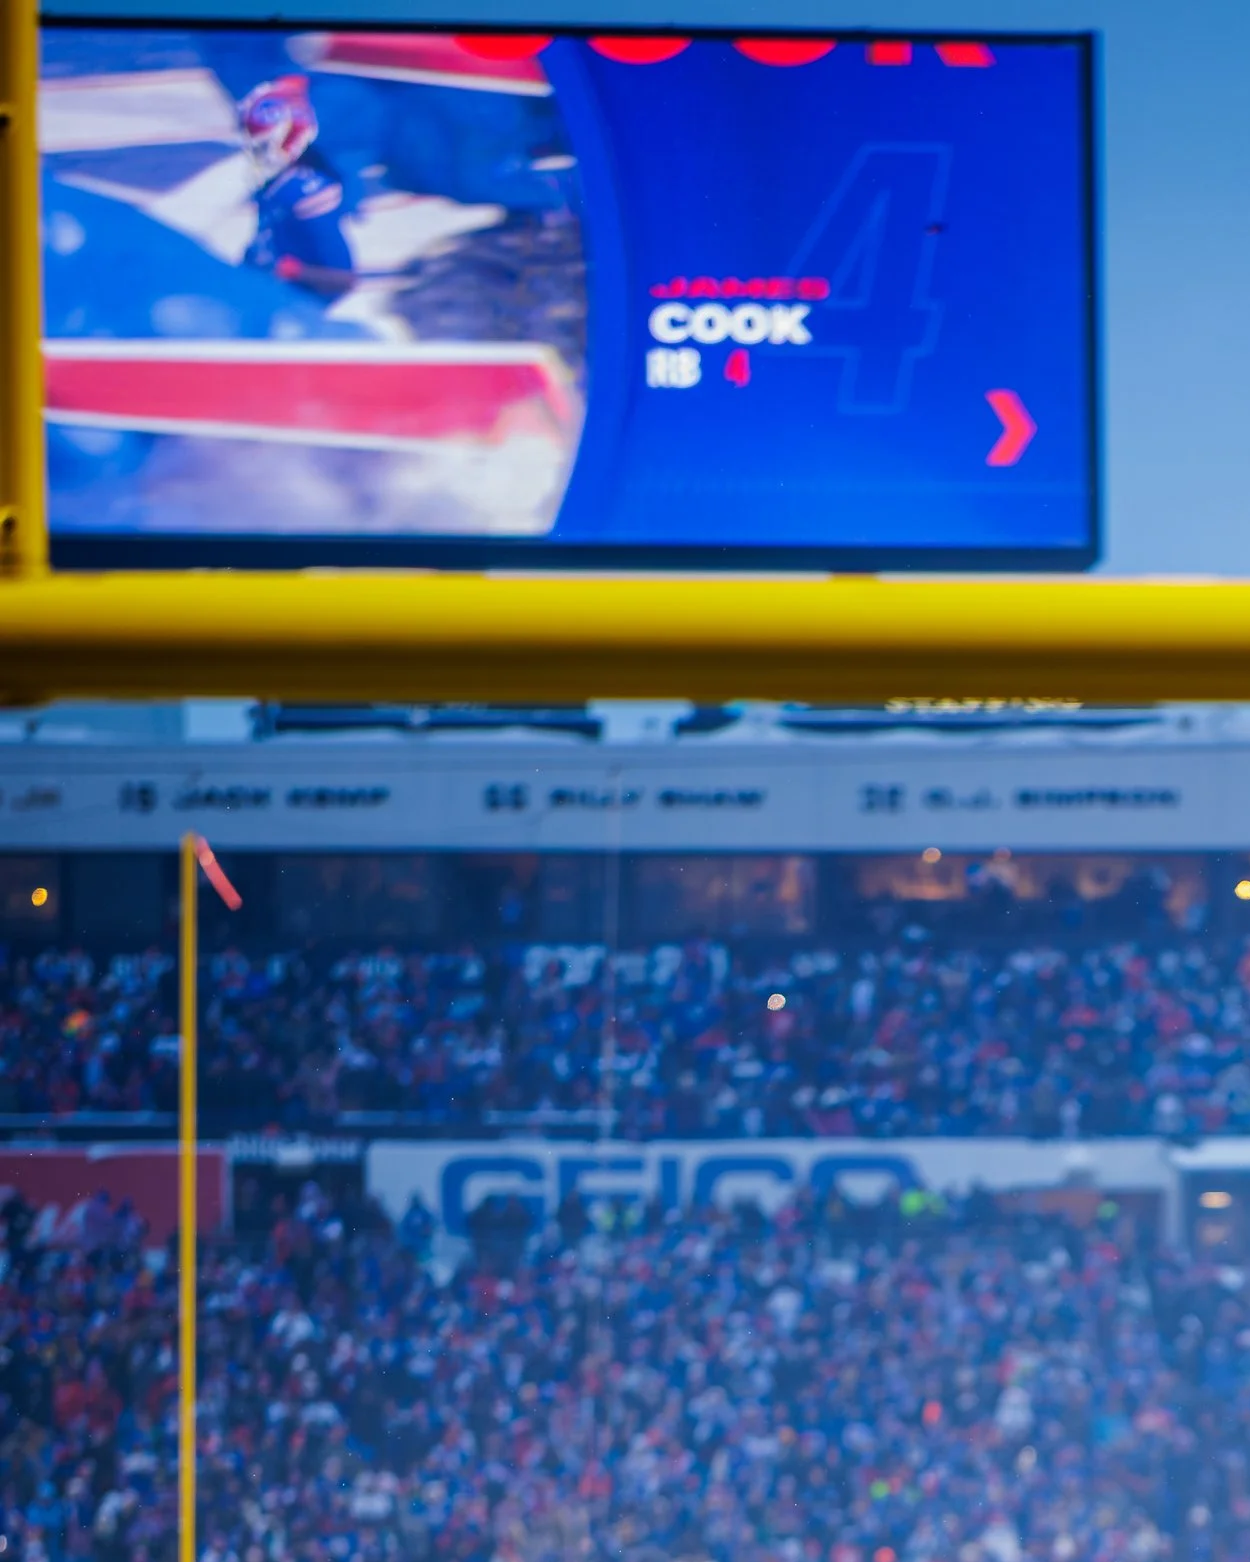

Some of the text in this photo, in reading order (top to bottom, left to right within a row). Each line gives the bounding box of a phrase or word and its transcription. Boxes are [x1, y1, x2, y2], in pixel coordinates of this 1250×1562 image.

[648, 302, 812, 344] COOK
[723, 348, 750, 388] 4
[441, 1153, 919, 1240] GEICO
